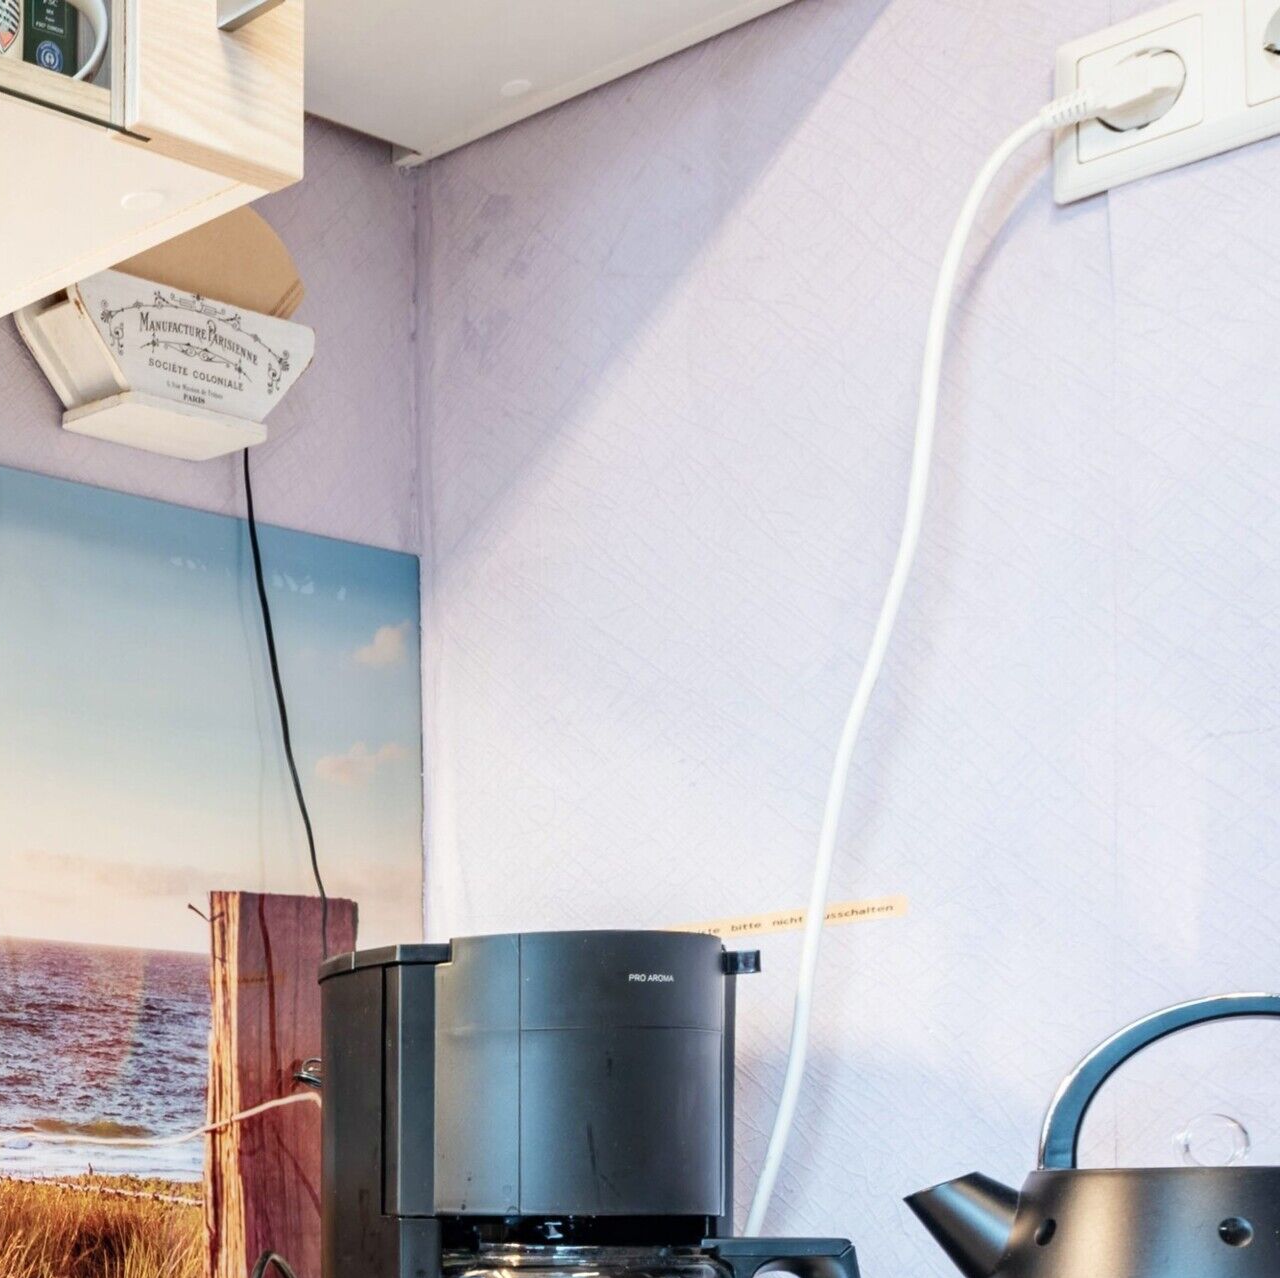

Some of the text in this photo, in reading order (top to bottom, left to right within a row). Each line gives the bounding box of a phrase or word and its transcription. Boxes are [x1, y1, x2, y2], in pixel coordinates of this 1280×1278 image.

[192, 370, 244, 391] COLONIALE
[772, 916, 803, 927] nicht
[823, 905, 894, 920] usschalten
[628, 973, 675, 983] PRO AROMA
